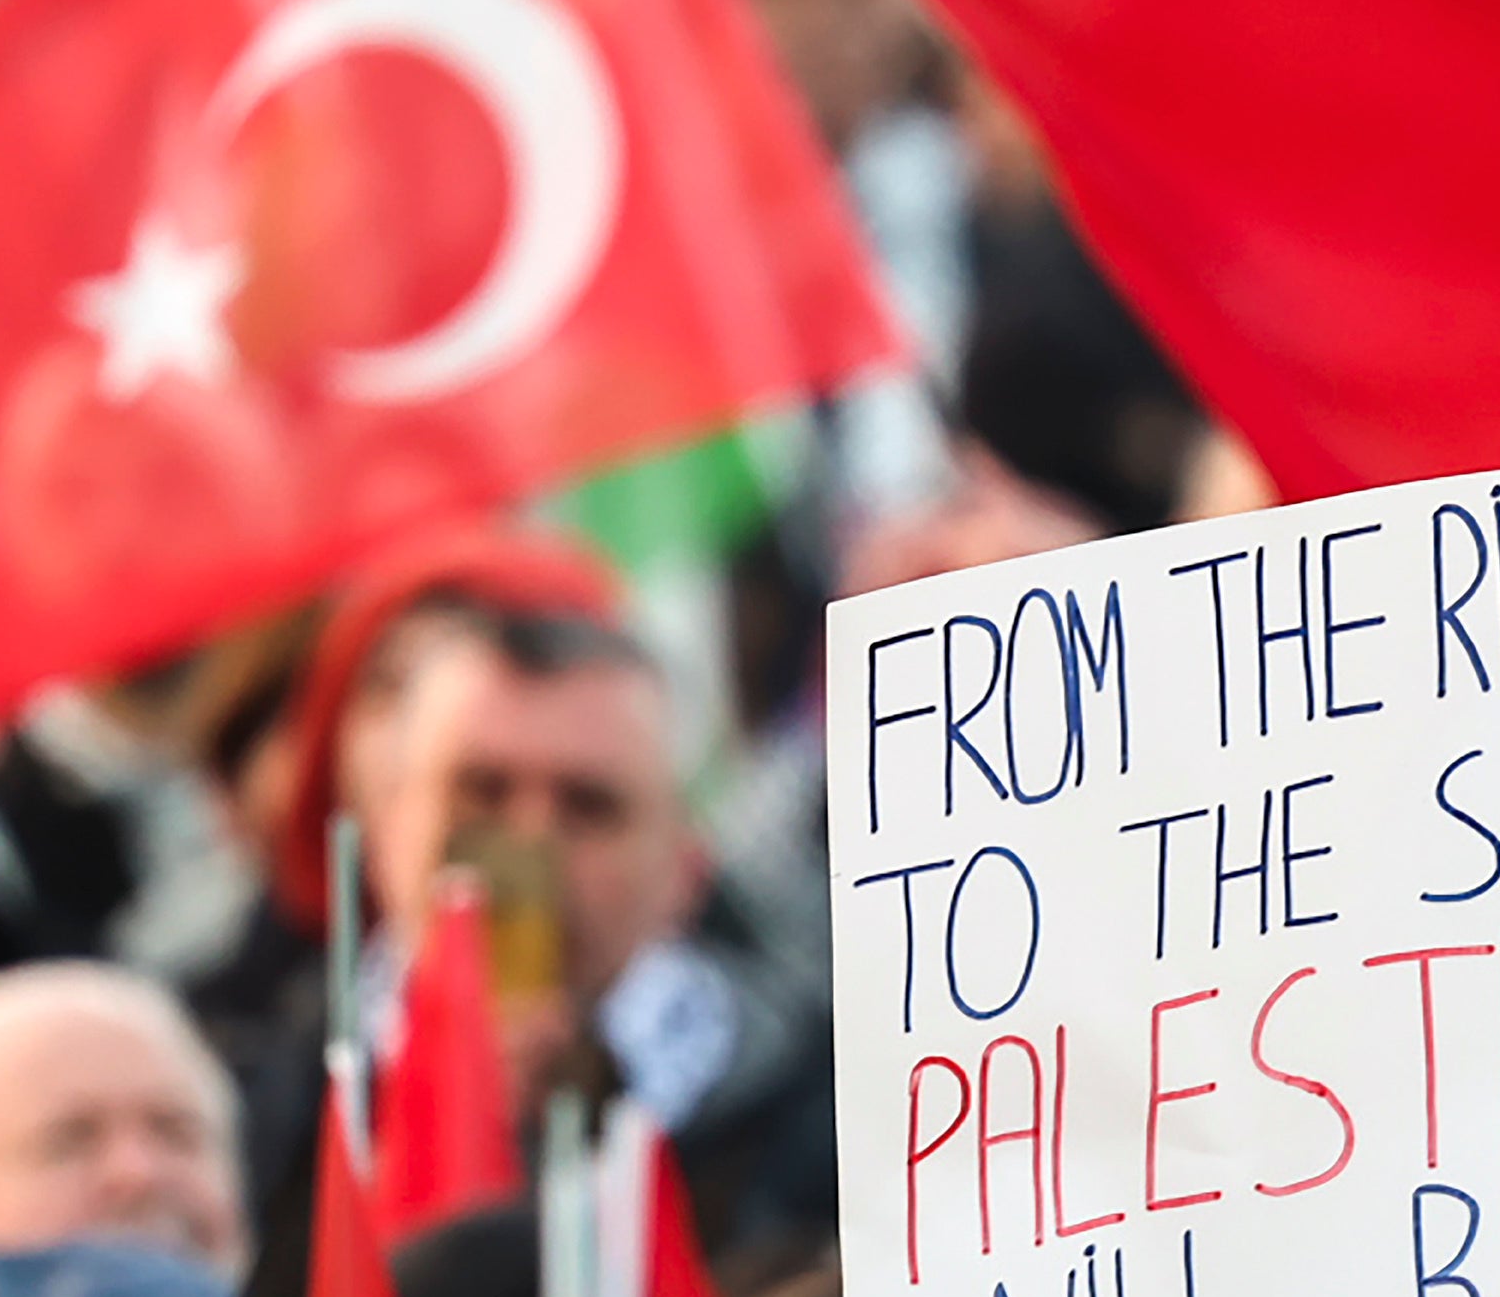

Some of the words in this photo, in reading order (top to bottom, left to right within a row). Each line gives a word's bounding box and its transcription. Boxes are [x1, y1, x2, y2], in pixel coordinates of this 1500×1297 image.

[868, 580, 1129, 834] FROM
[1169, 522, 1386, 748] THE
[853, 846, 1041, 1034] TO
[1119, 774, 1339, 960] THE
